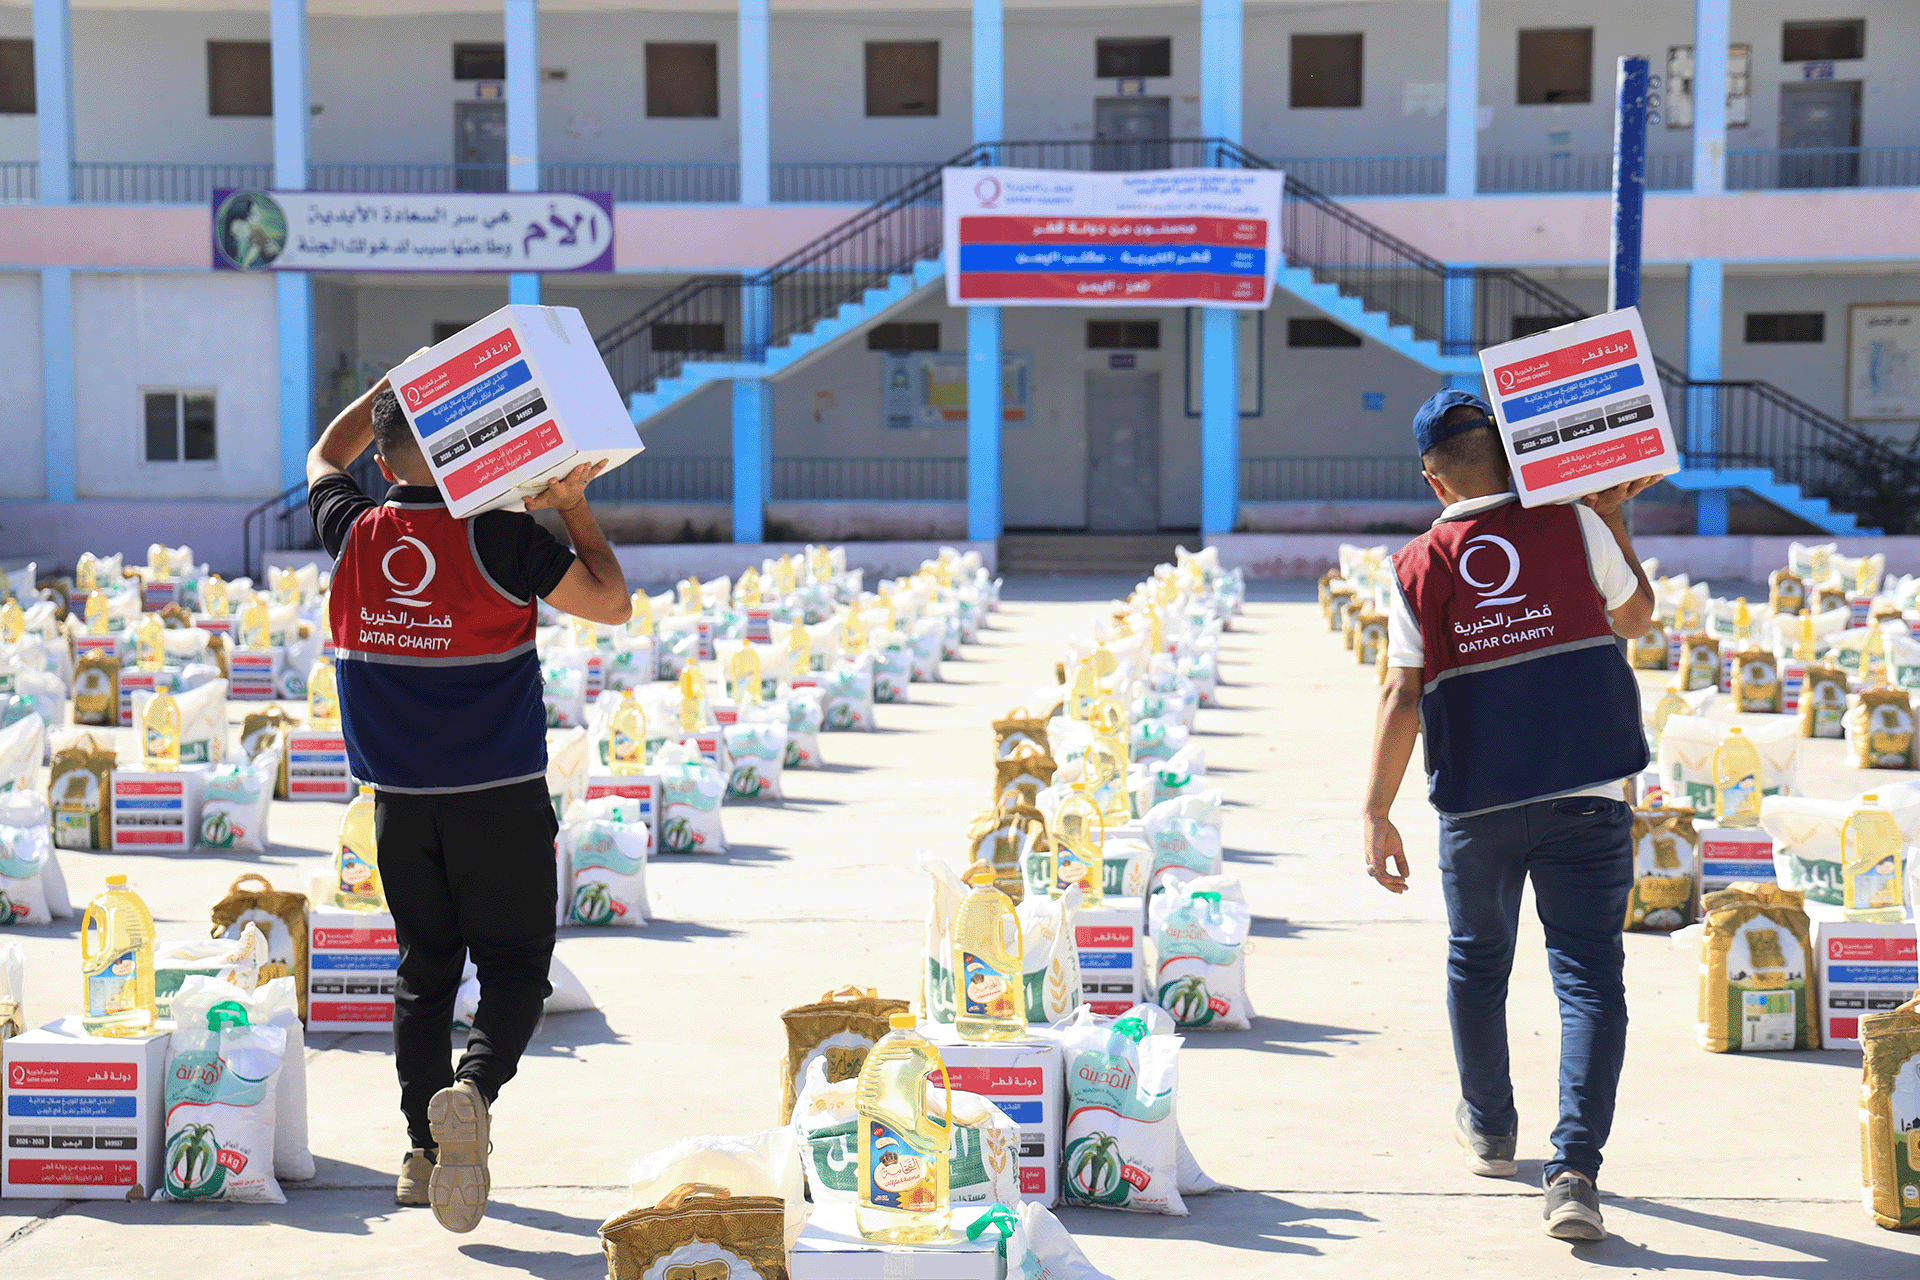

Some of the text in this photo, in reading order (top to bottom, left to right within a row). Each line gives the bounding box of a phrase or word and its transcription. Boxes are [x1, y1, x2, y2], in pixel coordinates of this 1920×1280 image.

[519, 203, 599, 260] الأم
[474, 342, 512, 369] دولة قطر
[1582, 343, 1628, 364] دولة قطر
[481, 426, 498, 441] اليمن
[1573, 424, 1595, 437] اليمن
[360, 606, 452, 629] قطر الخيرية
[1454, 604, 1552, 636] قطر الخيرية
[360, 629, 451, 650] QATAR CHARITY
[1458, 625, 1554, 653] QATAR CHARITY
[87, 1071, 132, 1083] دولة قطر
[990, 1076, 1037, 1089] دولة قطر
[1078, 1063, 1132, 1091] المدينة
[219, 1152, 239, 1169] 5 kg
[1123, 1167, 1144, 1187] 5 kg
